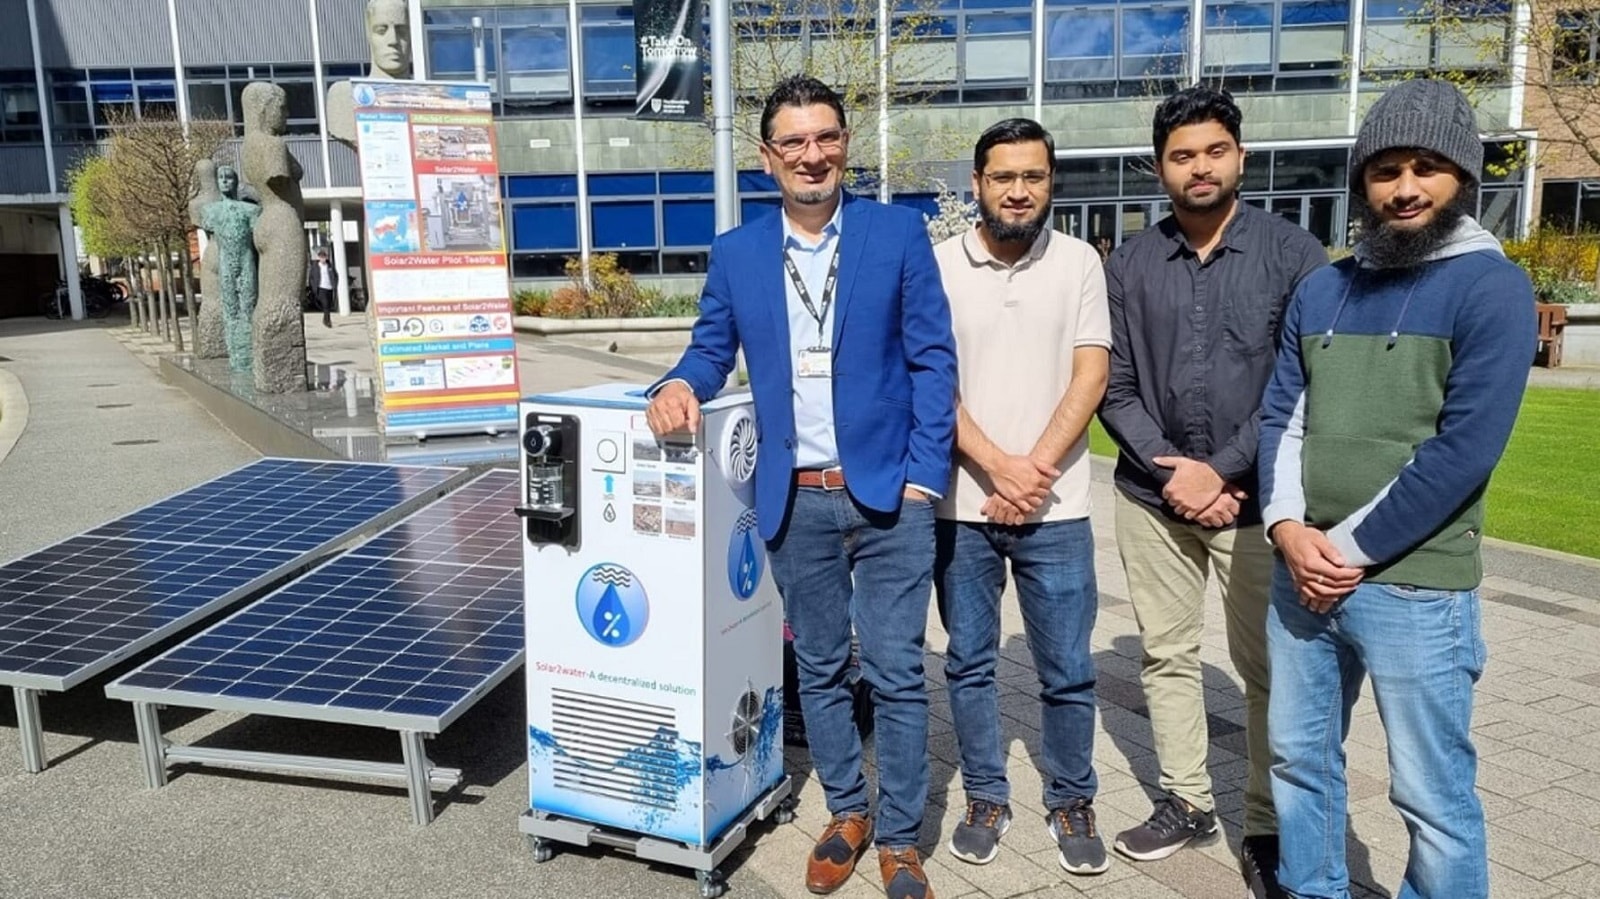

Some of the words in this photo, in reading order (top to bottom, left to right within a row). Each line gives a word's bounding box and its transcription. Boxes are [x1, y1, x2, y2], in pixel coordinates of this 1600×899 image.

[640, 44, 698, 57] Tomorrow
[383, 256, 440, 265] Solar2Water
[442, 255, 463, 264] Pilot
[464, 255, 496, 265] Testing
[377, 305, 415, 314] Important
[417, 304, 452, 312] Features
[462, 302, 509, 310] Solar2Water
[383, 344, 421, 353] Estimated
[423, 342, 450, 351] Market
[452, 342, 467, 350] and
[597, 671, 657, 690] decentralized
[658, 682, 697, 697] solution
